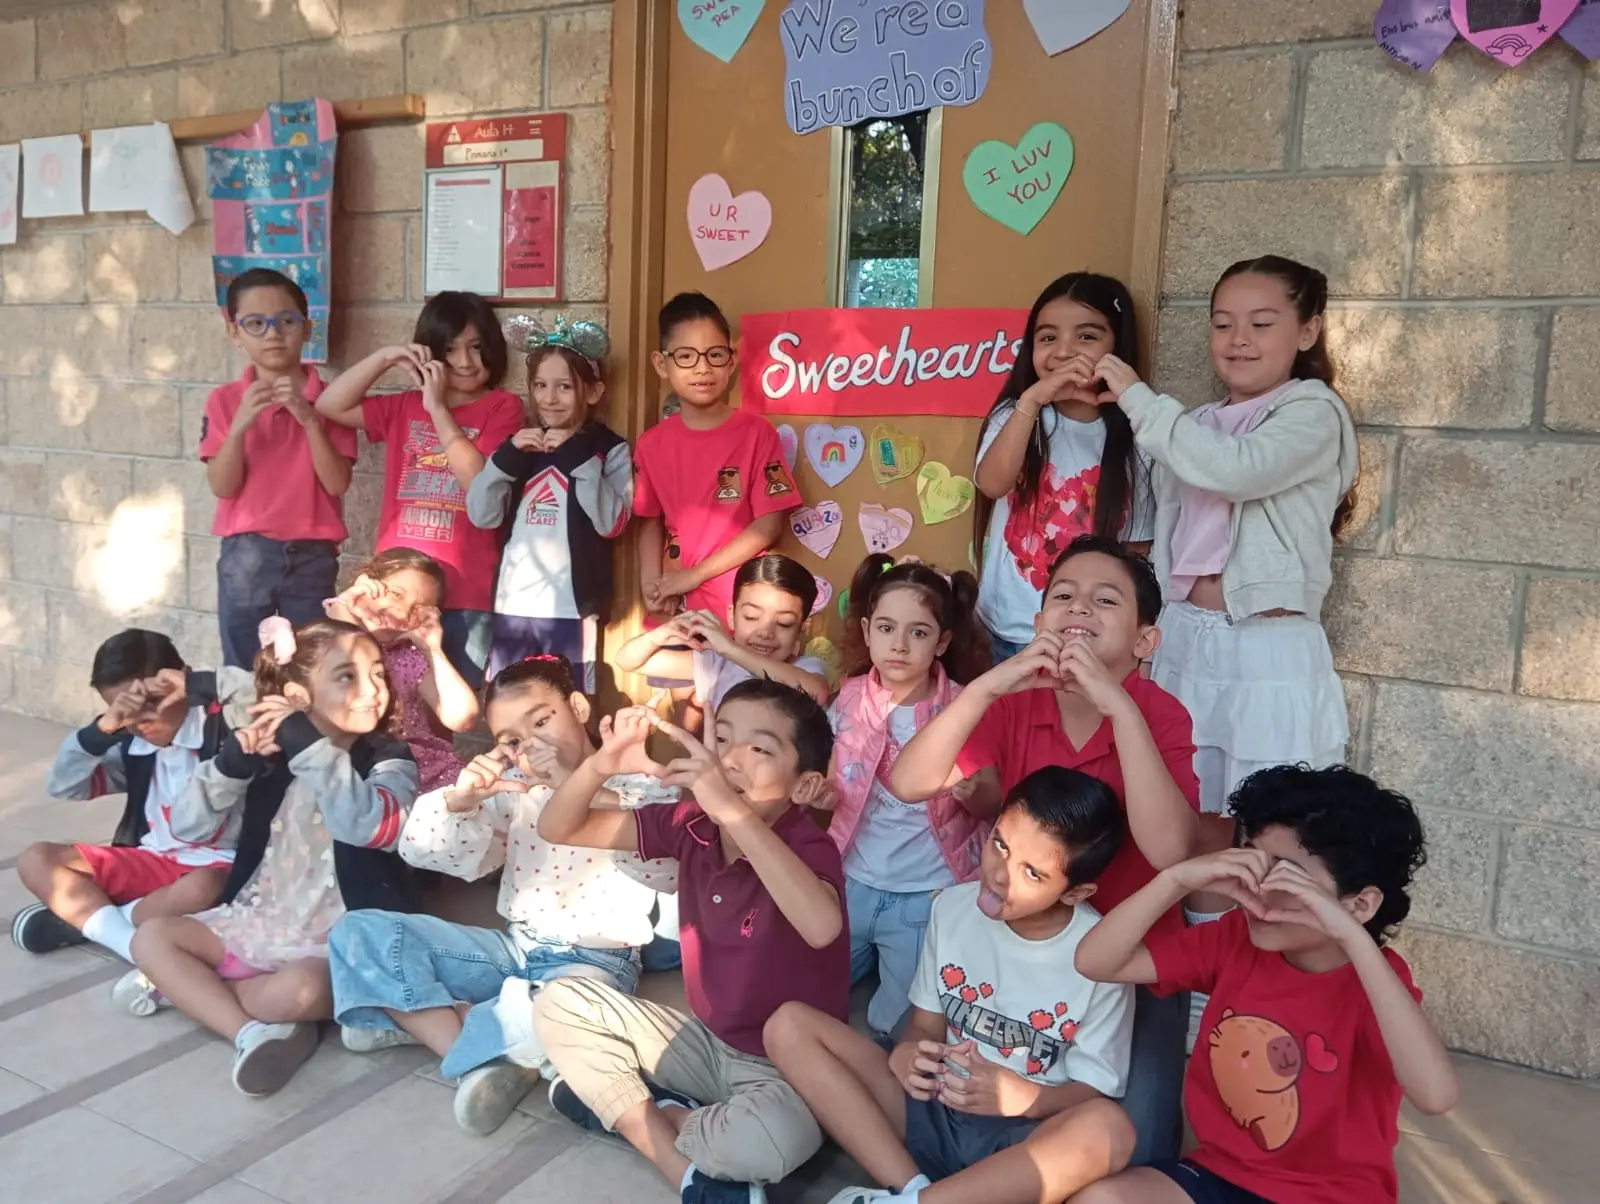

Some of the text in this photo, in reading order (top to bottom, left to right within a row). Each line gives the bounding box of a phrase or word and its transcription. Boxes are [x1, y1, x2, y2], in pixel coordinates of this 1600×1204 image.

[711, 5, 740, 27] PEA
[790, 40, 985, 133] bunch of
[473, 121, 500, 138] Aula
[982, 140, 1052, 186] I LUV
[1006, 171, 1052, 205] YOU
[709, 202, 738, 223] U R
[695, 225, 751, 242] SWEET
[762, 325, 1024, 399] Sweethearts
